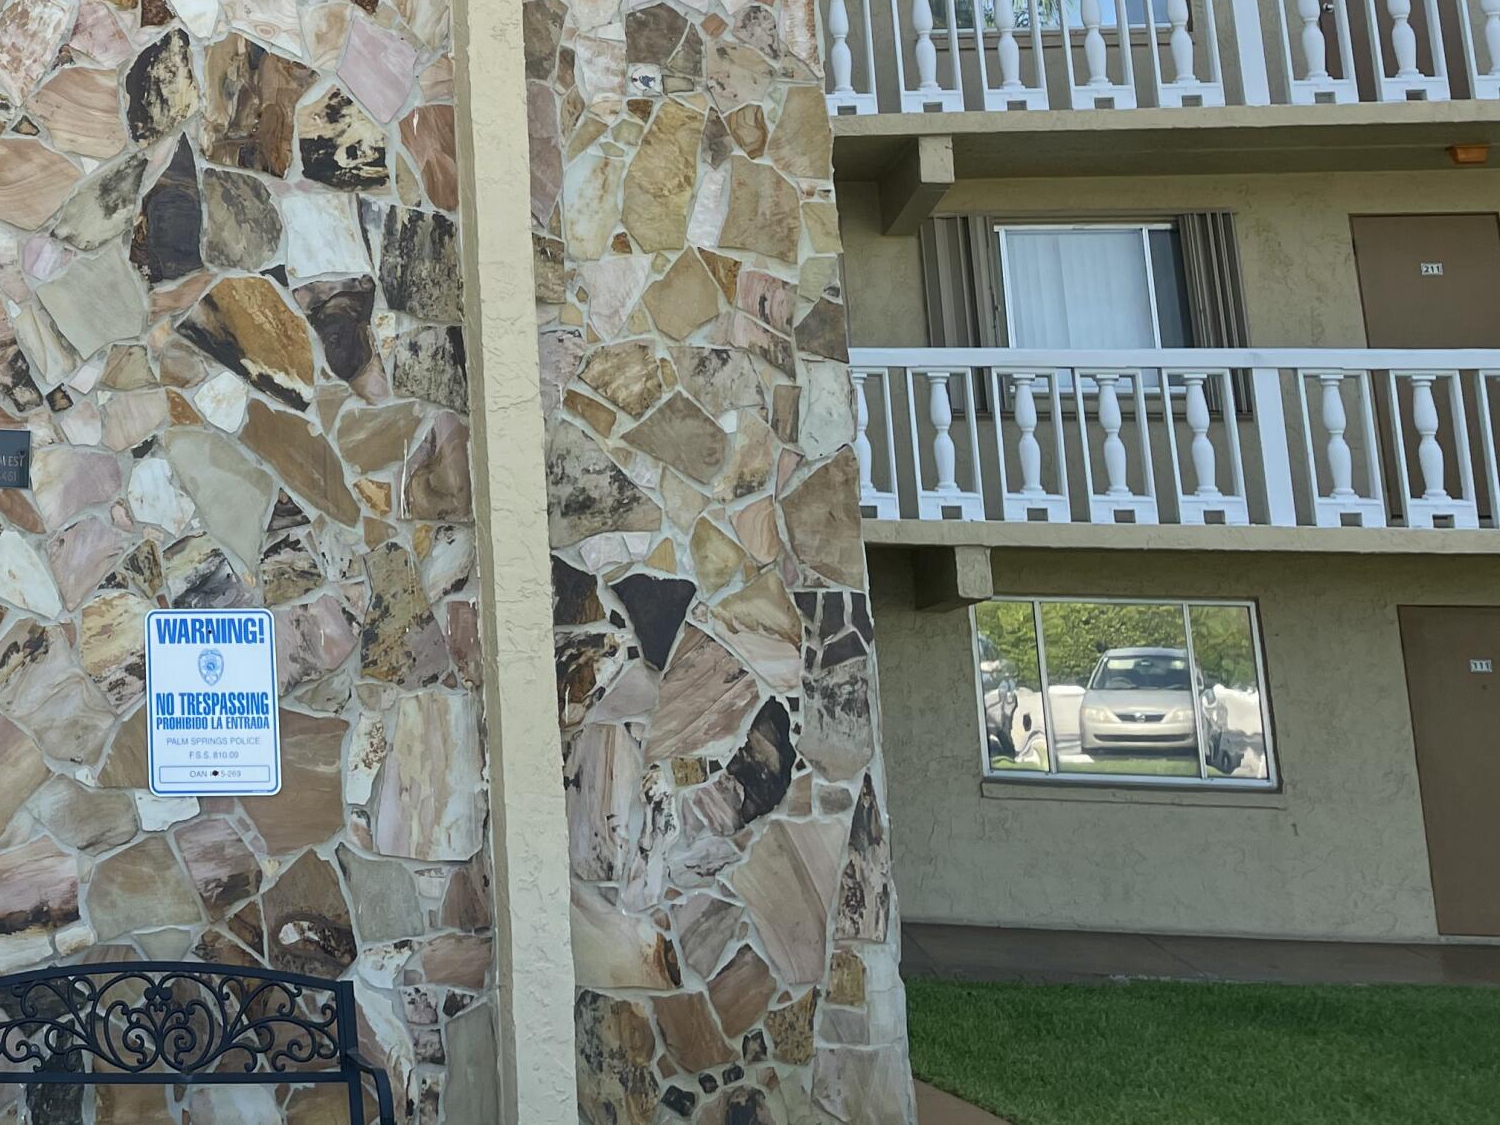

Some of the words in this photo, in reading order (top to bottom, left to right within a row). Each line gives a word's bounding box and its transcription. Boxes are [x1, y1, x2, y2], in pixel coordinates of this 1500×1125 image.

[155, 617, 265, 645] WARNING!
[156, 692, 175, 716] NO
[178, 691, 270, 716] TRESPASSING
[156, 716, 209, 731] PROHIBIDO
[211, 716, 224, 730] LA
[226, 716, 270, 730] ENTRADA
[166, 737, 189, 746] PALM
[190, 737, 228, 746] SPRINGS
[230, 737, 260, 745] POLICE
